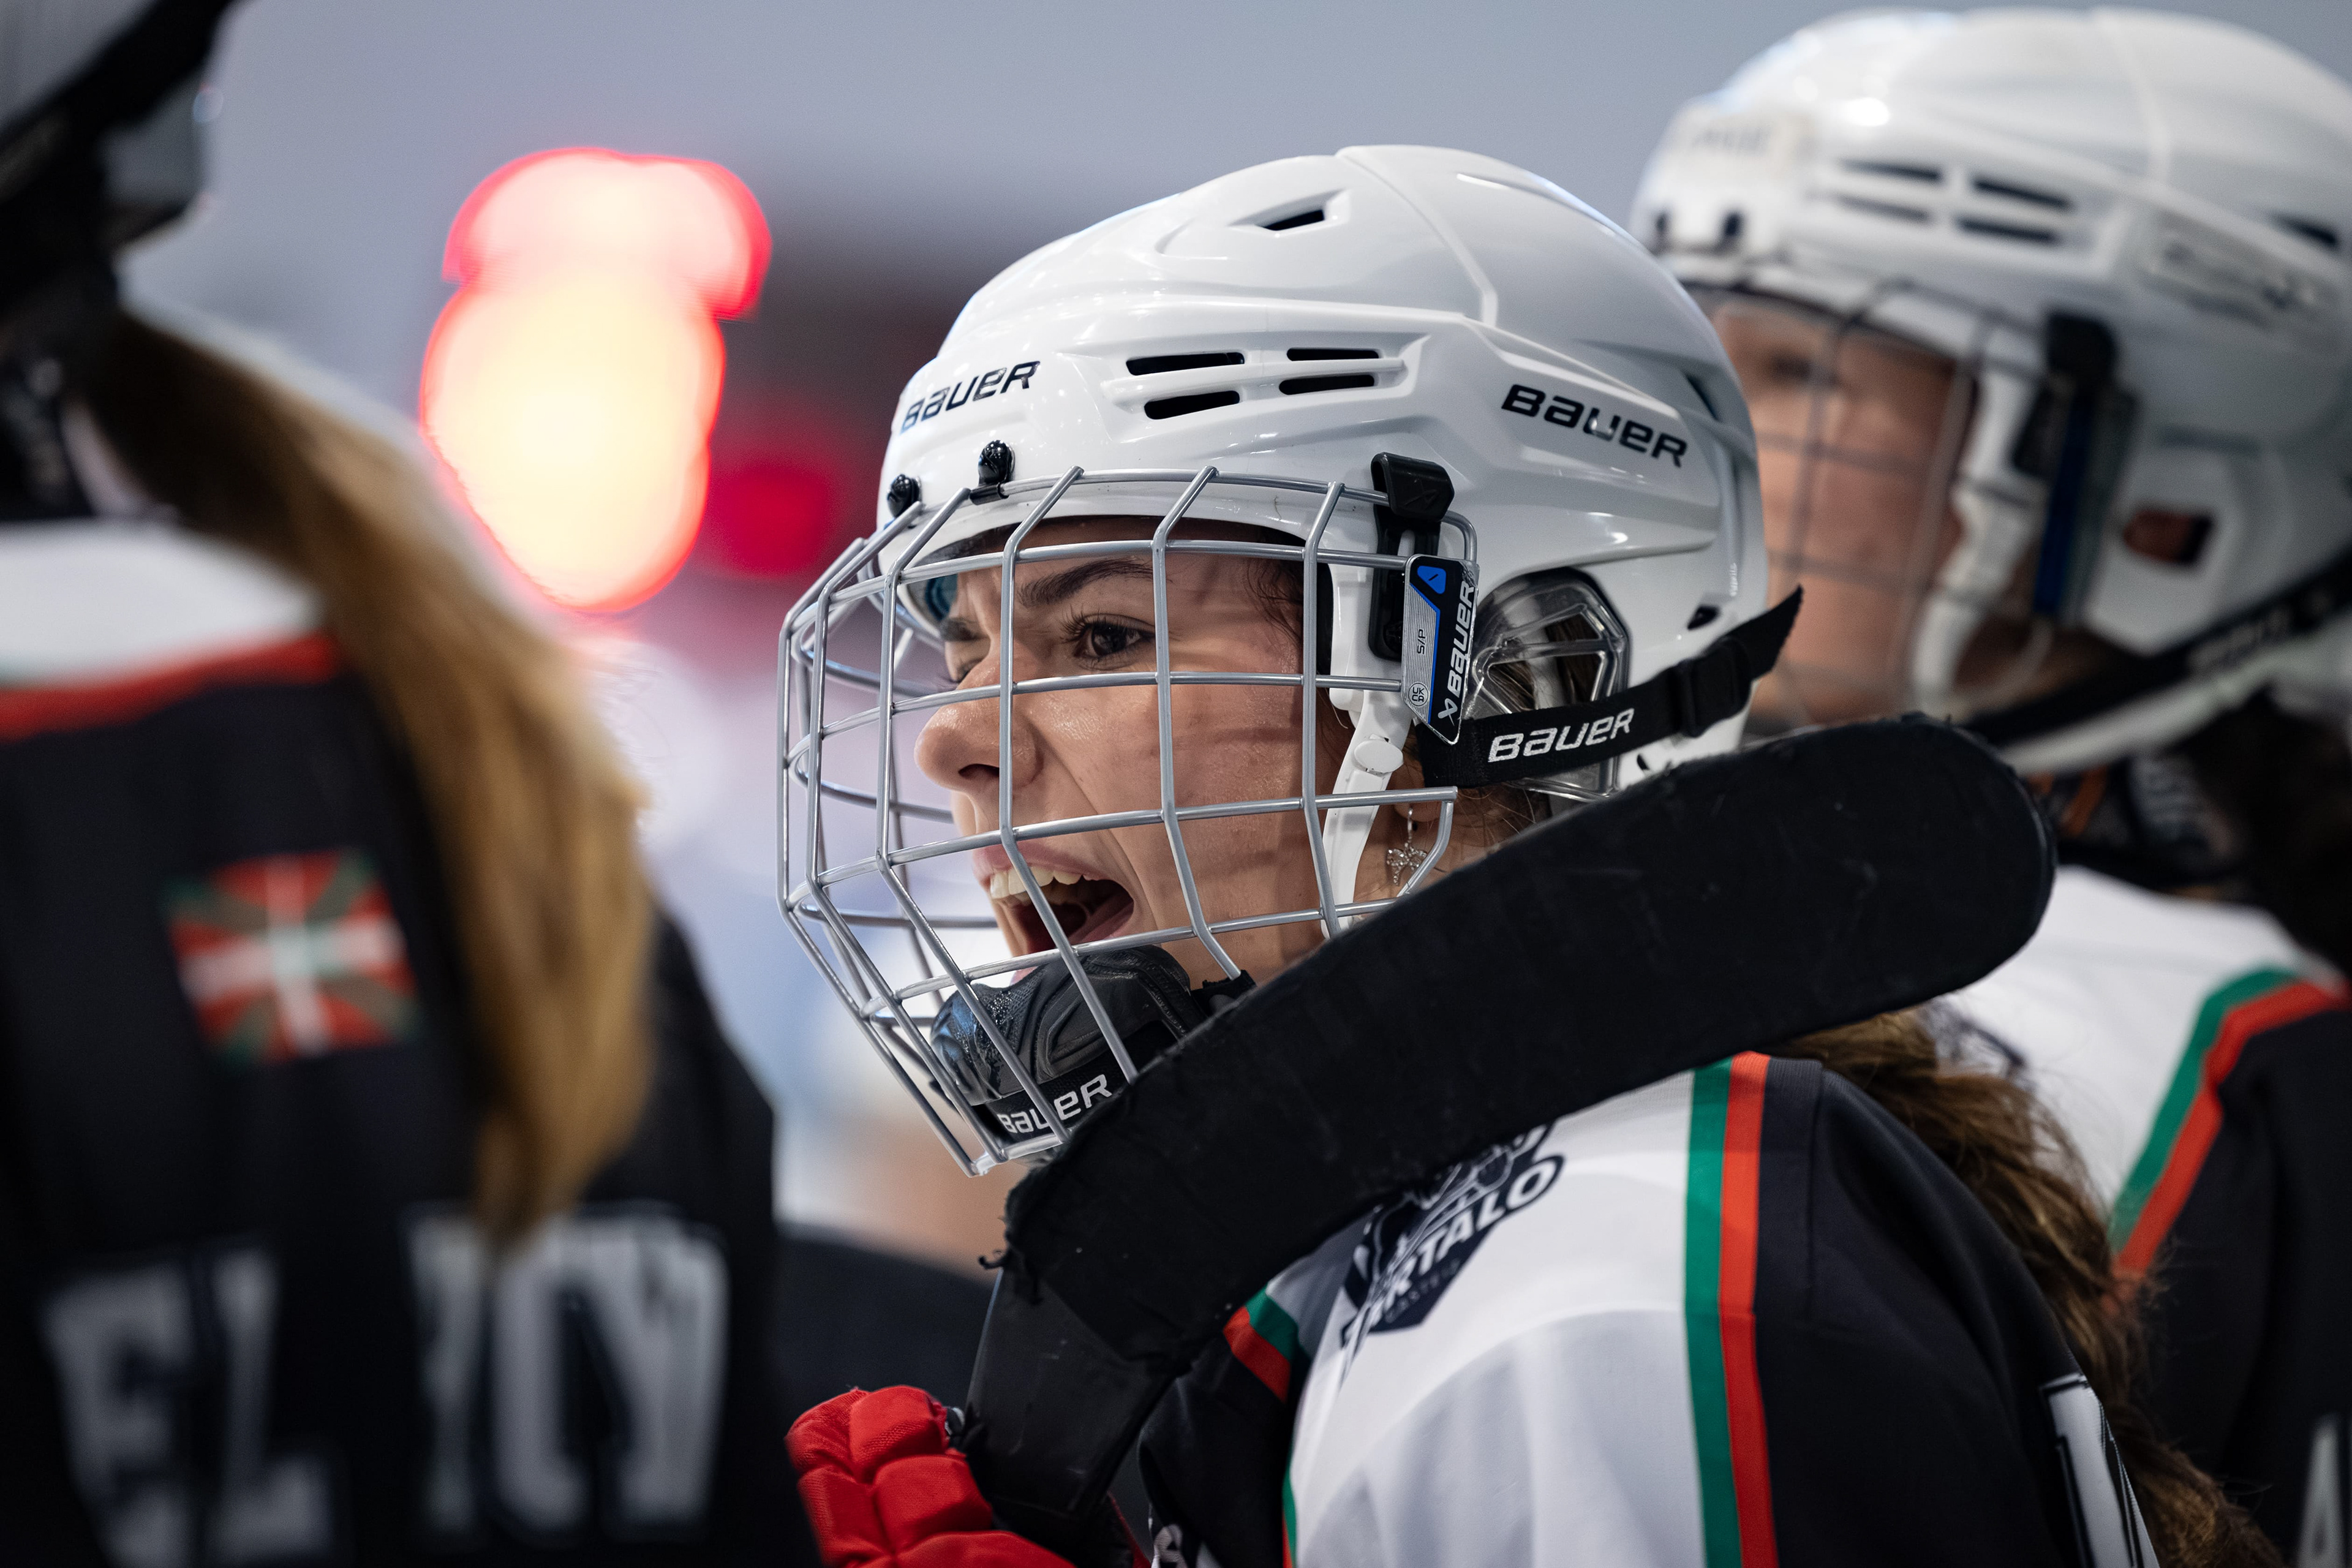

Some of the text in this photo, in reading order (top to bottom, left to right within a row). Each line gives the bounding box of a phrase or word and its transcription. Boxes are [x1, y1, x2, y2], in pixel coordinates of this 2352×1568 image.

[900, 361, 1040, 434] BAUER
[1501, 384, 1687, 468] BAUER
[1417, 628, 1427, 655] S/P
[1447, 581, 1475, 698] BAUER
[1488, 708, 1635, 763] BAUER
